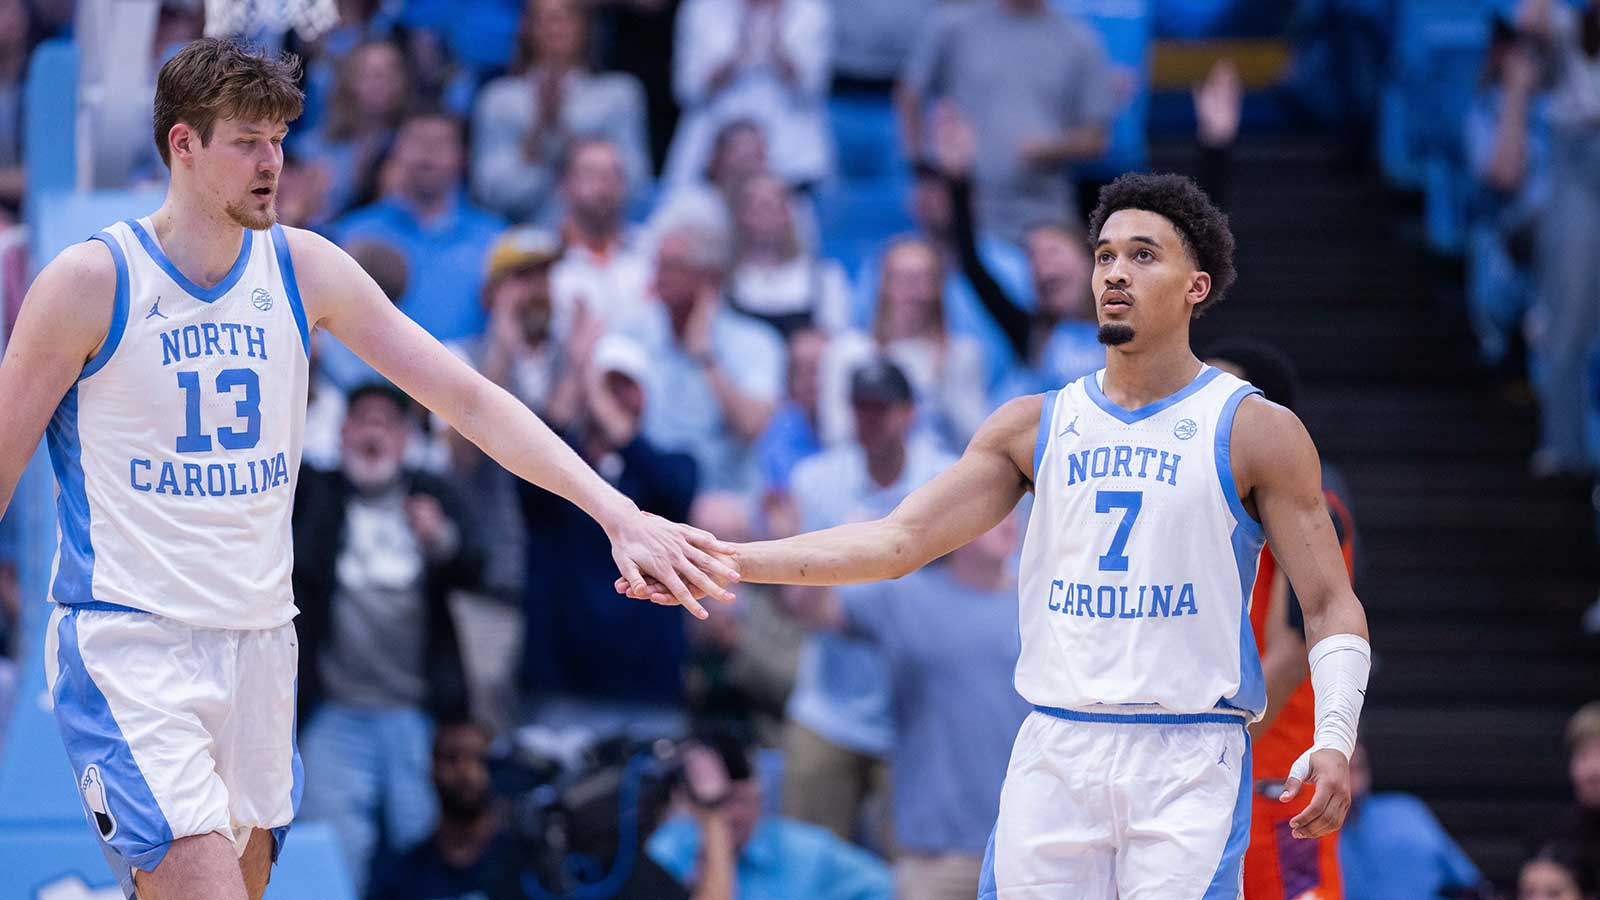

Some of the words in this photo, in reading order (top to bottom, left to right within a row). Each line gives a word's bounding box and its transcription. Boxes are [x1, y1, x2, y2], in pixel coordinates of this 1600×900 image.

[160, 322, 268, 366] NORTH
[176, 368, 262, 453] 13
[130, 452, 289, 497] CAROLINA
[1067, 445, 1182, 487] NORTH
[1095, 490, 1144, 573] 7
[1048, 579, 1198, 619] CAROLINA
